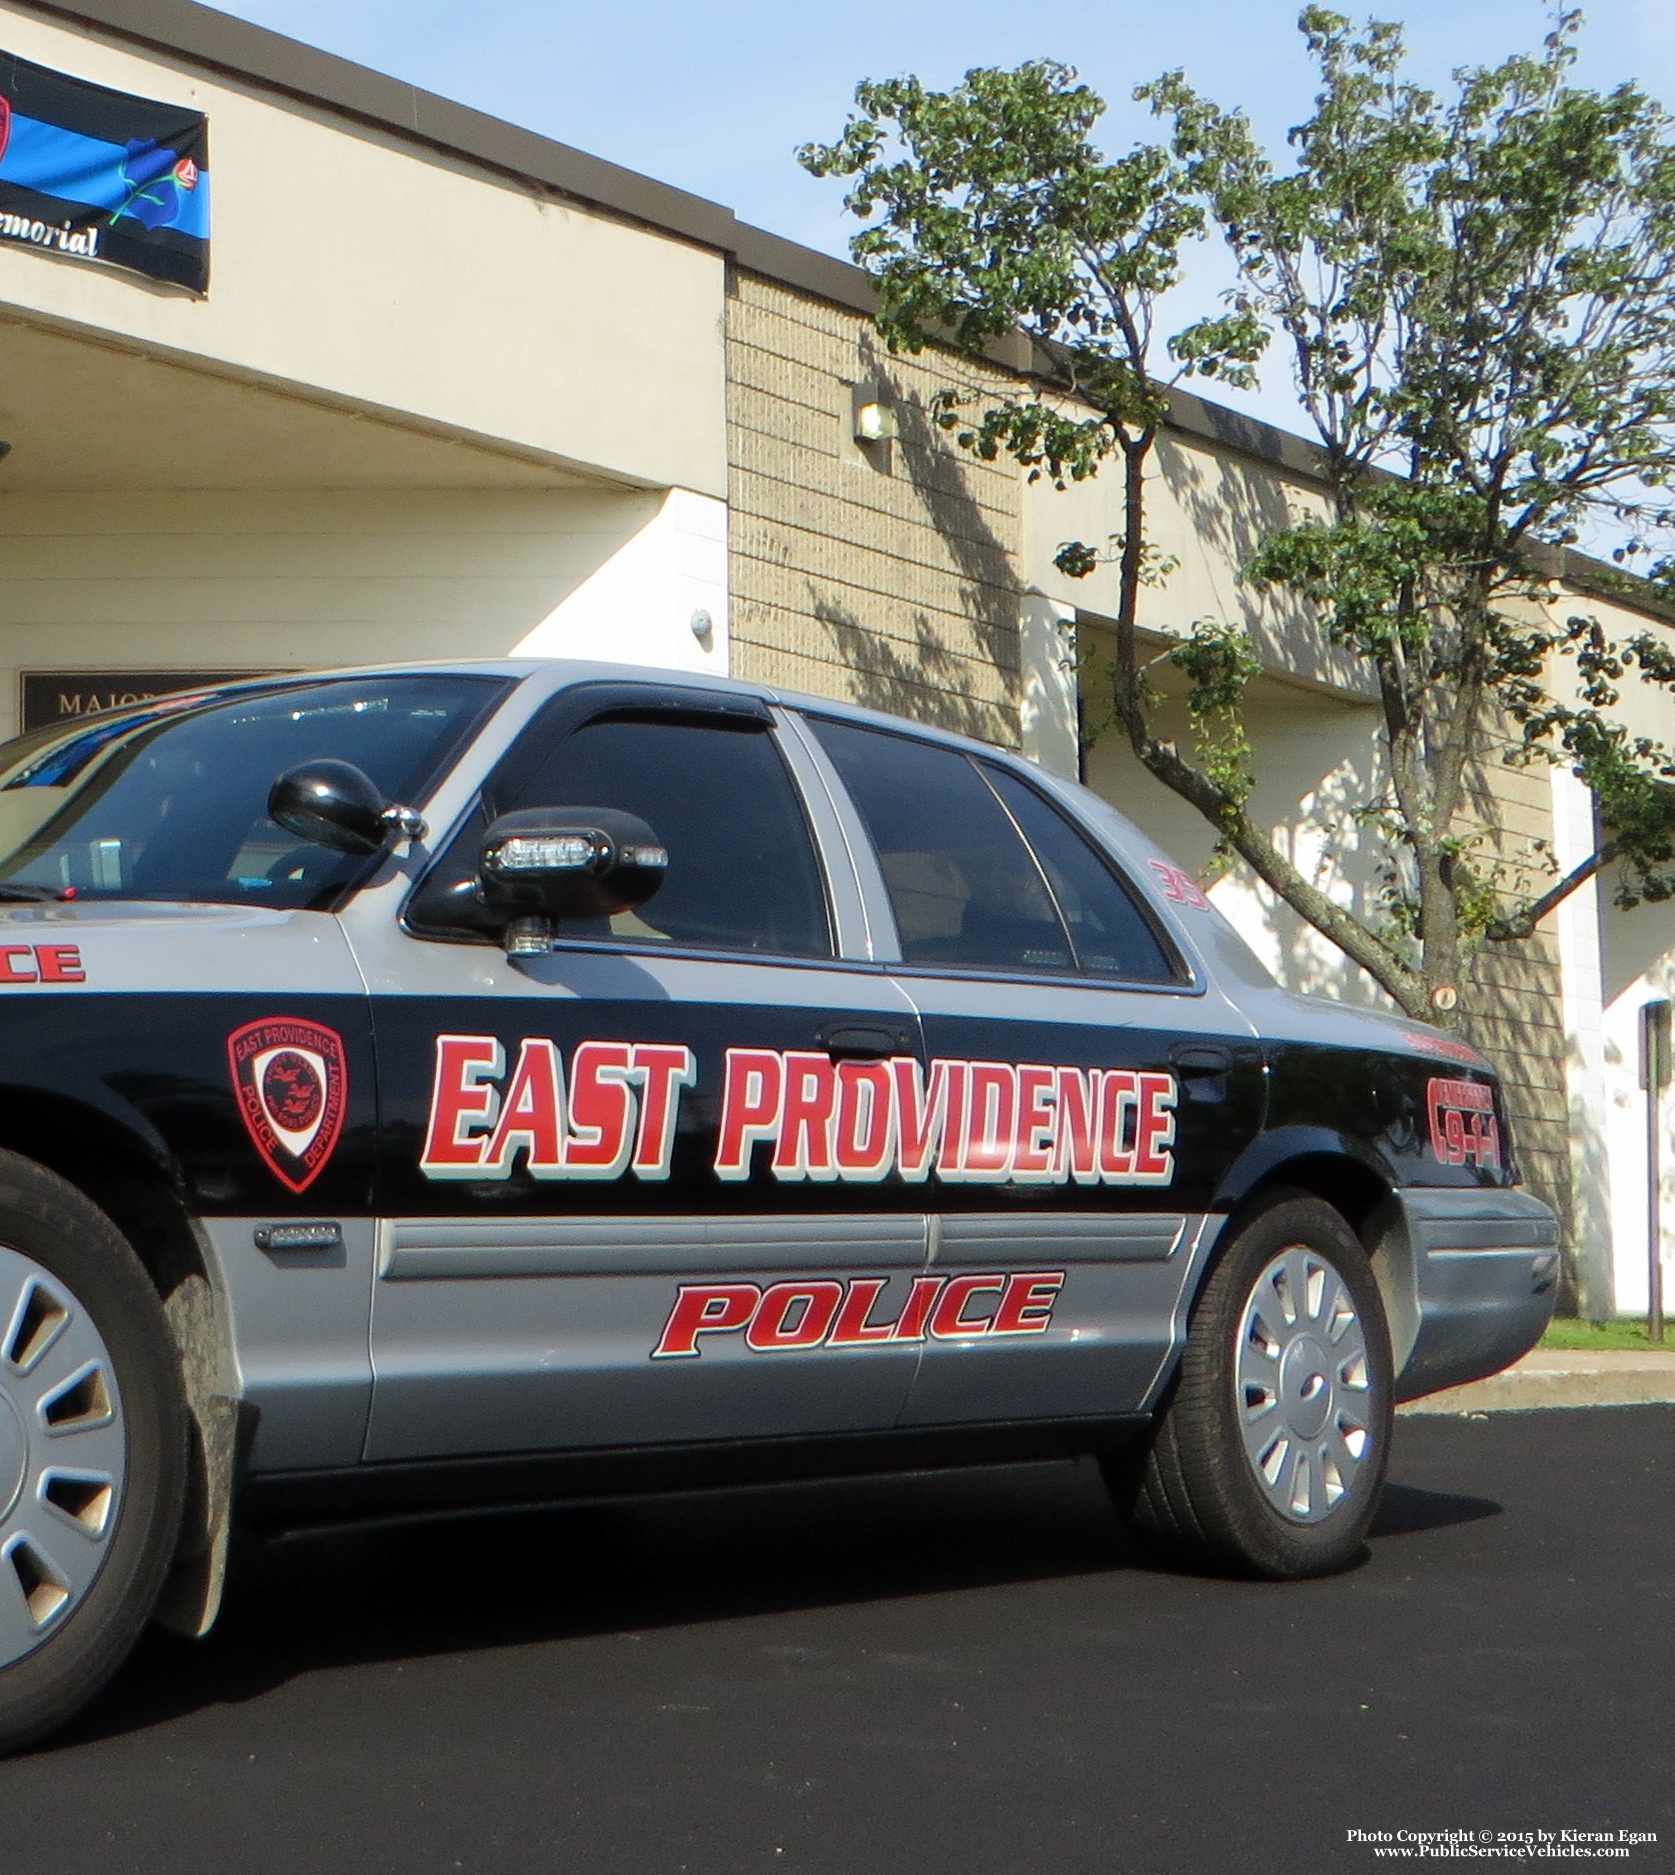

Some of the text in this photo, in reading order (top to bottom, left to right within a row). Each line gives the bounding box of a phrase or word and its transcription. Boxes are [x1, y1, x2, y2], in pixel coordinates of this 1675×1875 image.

[236, 1025, 337, 1061] EAST PROVIDENCE
[241, 1084, 278, 1154] POLICE
[304, 1061, 342, 1168] DEPARTMENT
[420, 1034, 697, 1181] EAST
[714, 1047, 1178, 1187] PROVIDENCE
[650, 1271, 1067, 1360] POLICE
